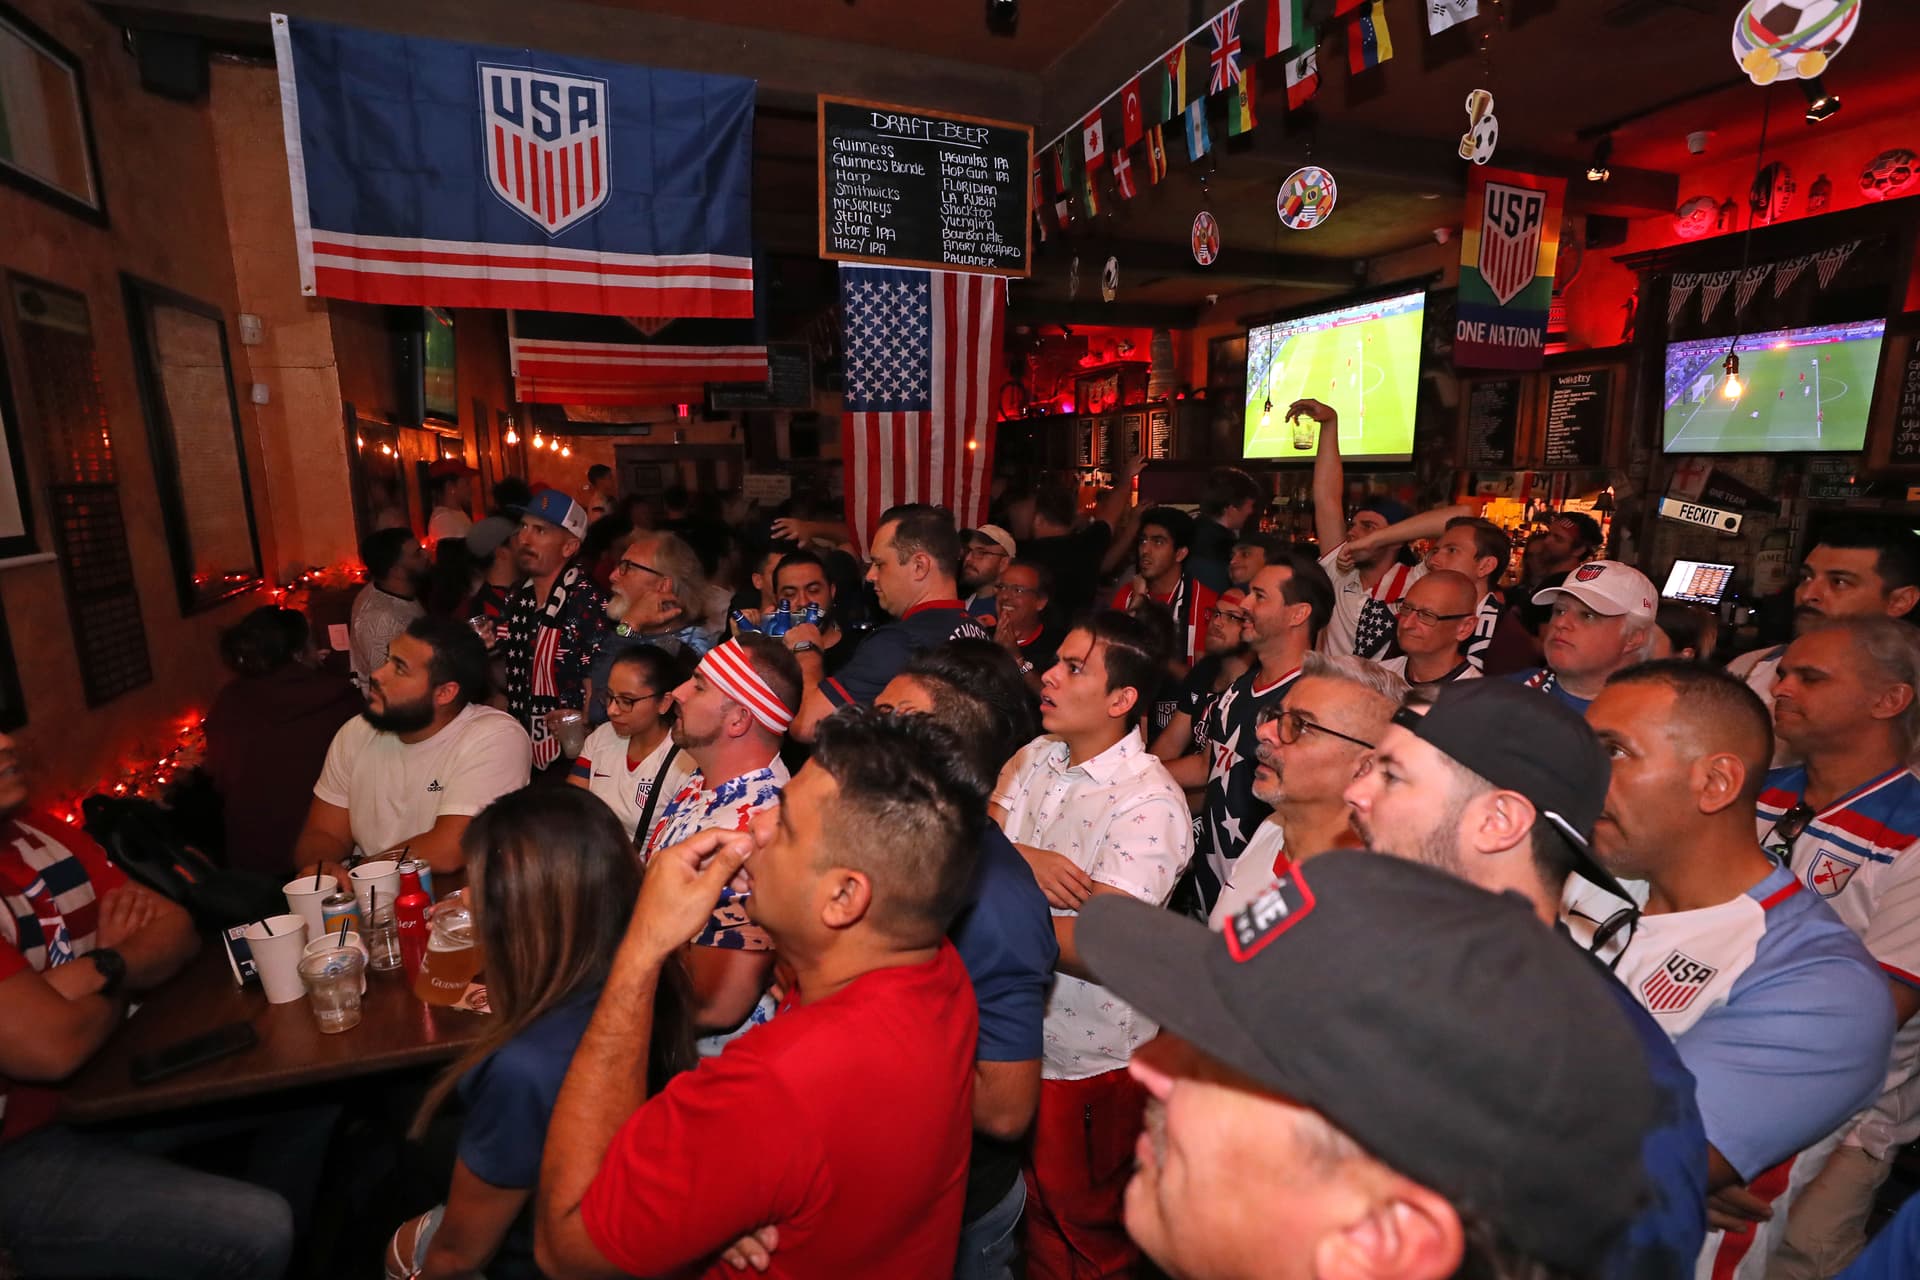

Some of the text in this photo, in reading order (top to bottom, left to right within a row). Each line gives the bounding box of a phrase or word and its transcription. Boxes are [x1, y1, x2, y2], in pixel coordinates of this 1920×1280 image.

[491, 74, 597, 142] USA
[870, 112, 988, 144] DRAFT BEER
[833, 137, 894, 158] Guinness
[833, 153, 888, 172] Guinness
[994, 157, 1009, 169] IPA
[836, 169, 871, 185] Harp
[995, 171, 1010, 183] IPA
[941, 190, 957, 204] LA
[1488, 189, 1542, 239] USA
[876, 226, 896, 241] IPA
[834, 237, 886, 256] HAZY IPA
[980, 243, 1021, 257] ORCHARD
[1673, 273, 1697, 287] USA
[1704, 271, 1732, 286] USA
[1457, 320, 1544, 349] ONE NATION.
[1679, 503, 1719, 526] FECKIT
[1666, 954, 1713, 985] USA
